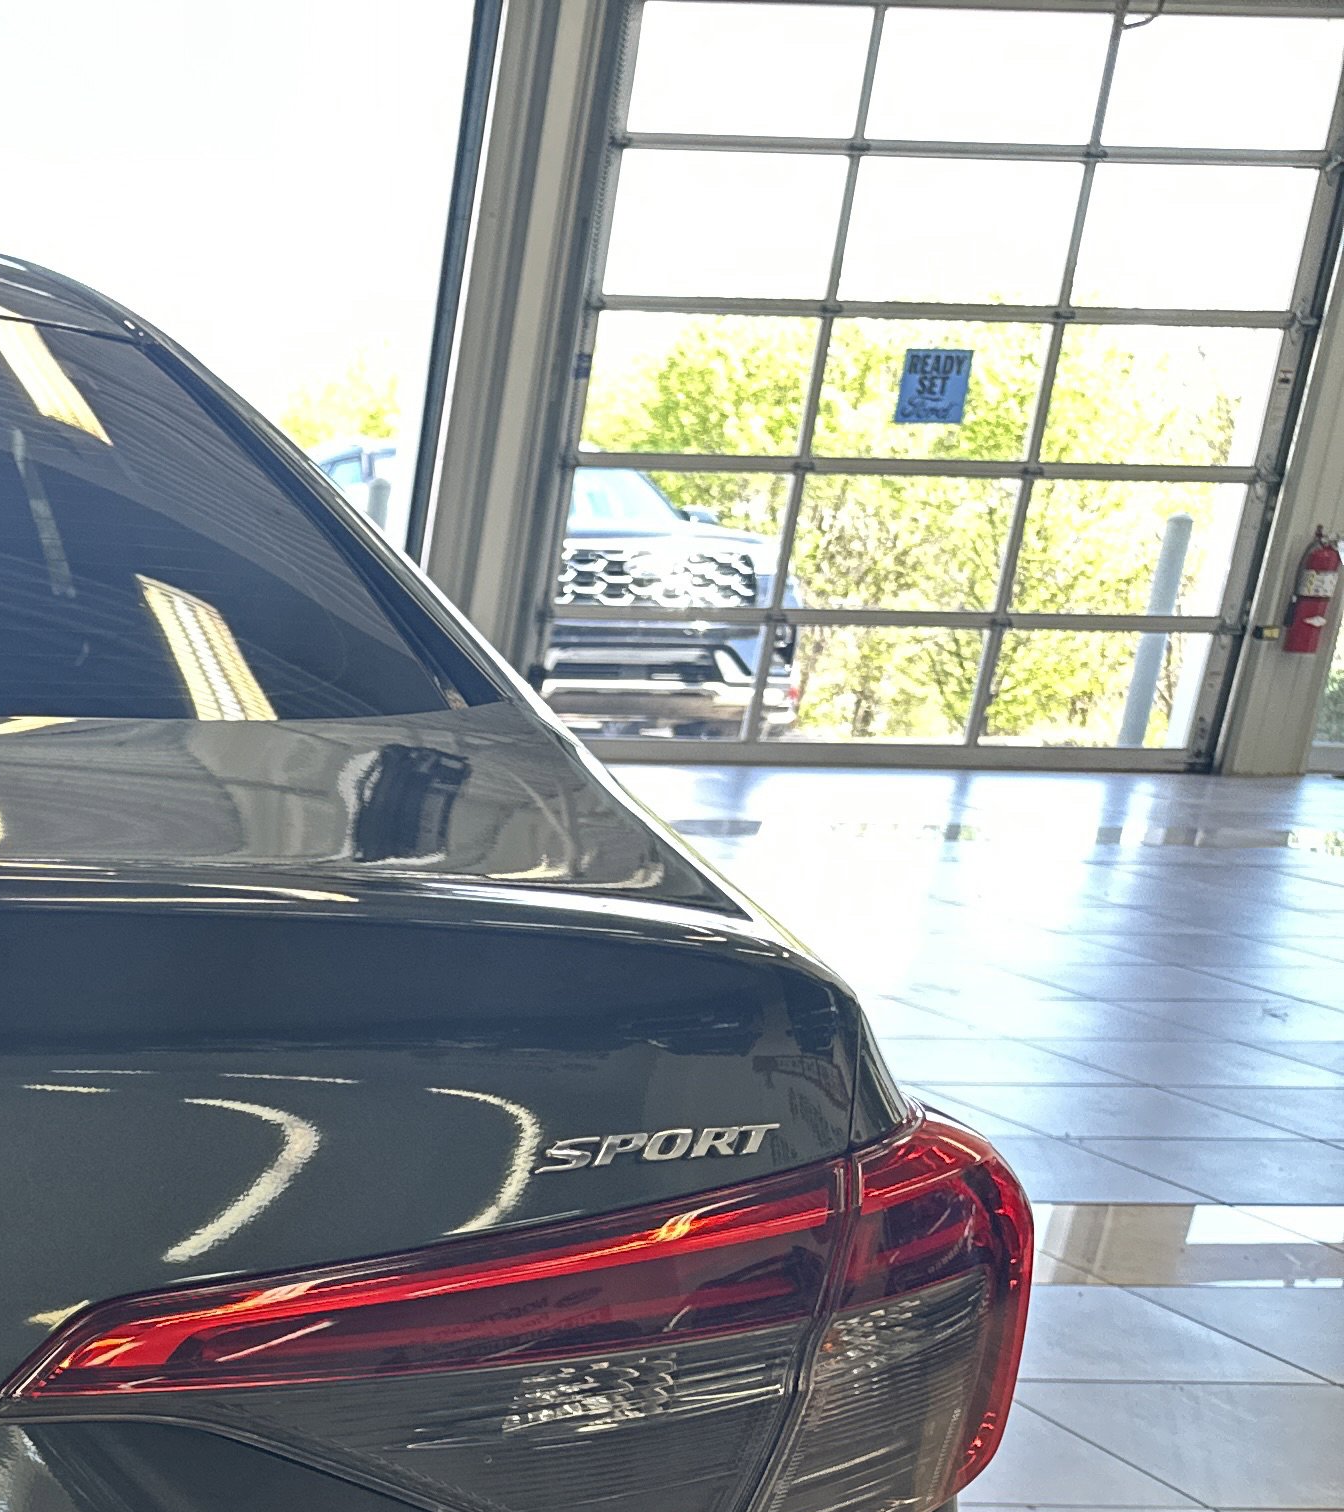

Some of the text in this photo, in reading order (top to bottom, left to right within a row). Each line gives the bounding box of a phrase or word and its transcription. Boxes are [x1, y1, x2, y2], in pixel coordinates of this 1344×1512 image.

[908, 354, 968, 375] READY
[916, 376, 950, 396] SET
[534, 1123, 781, 1175] SPORT
